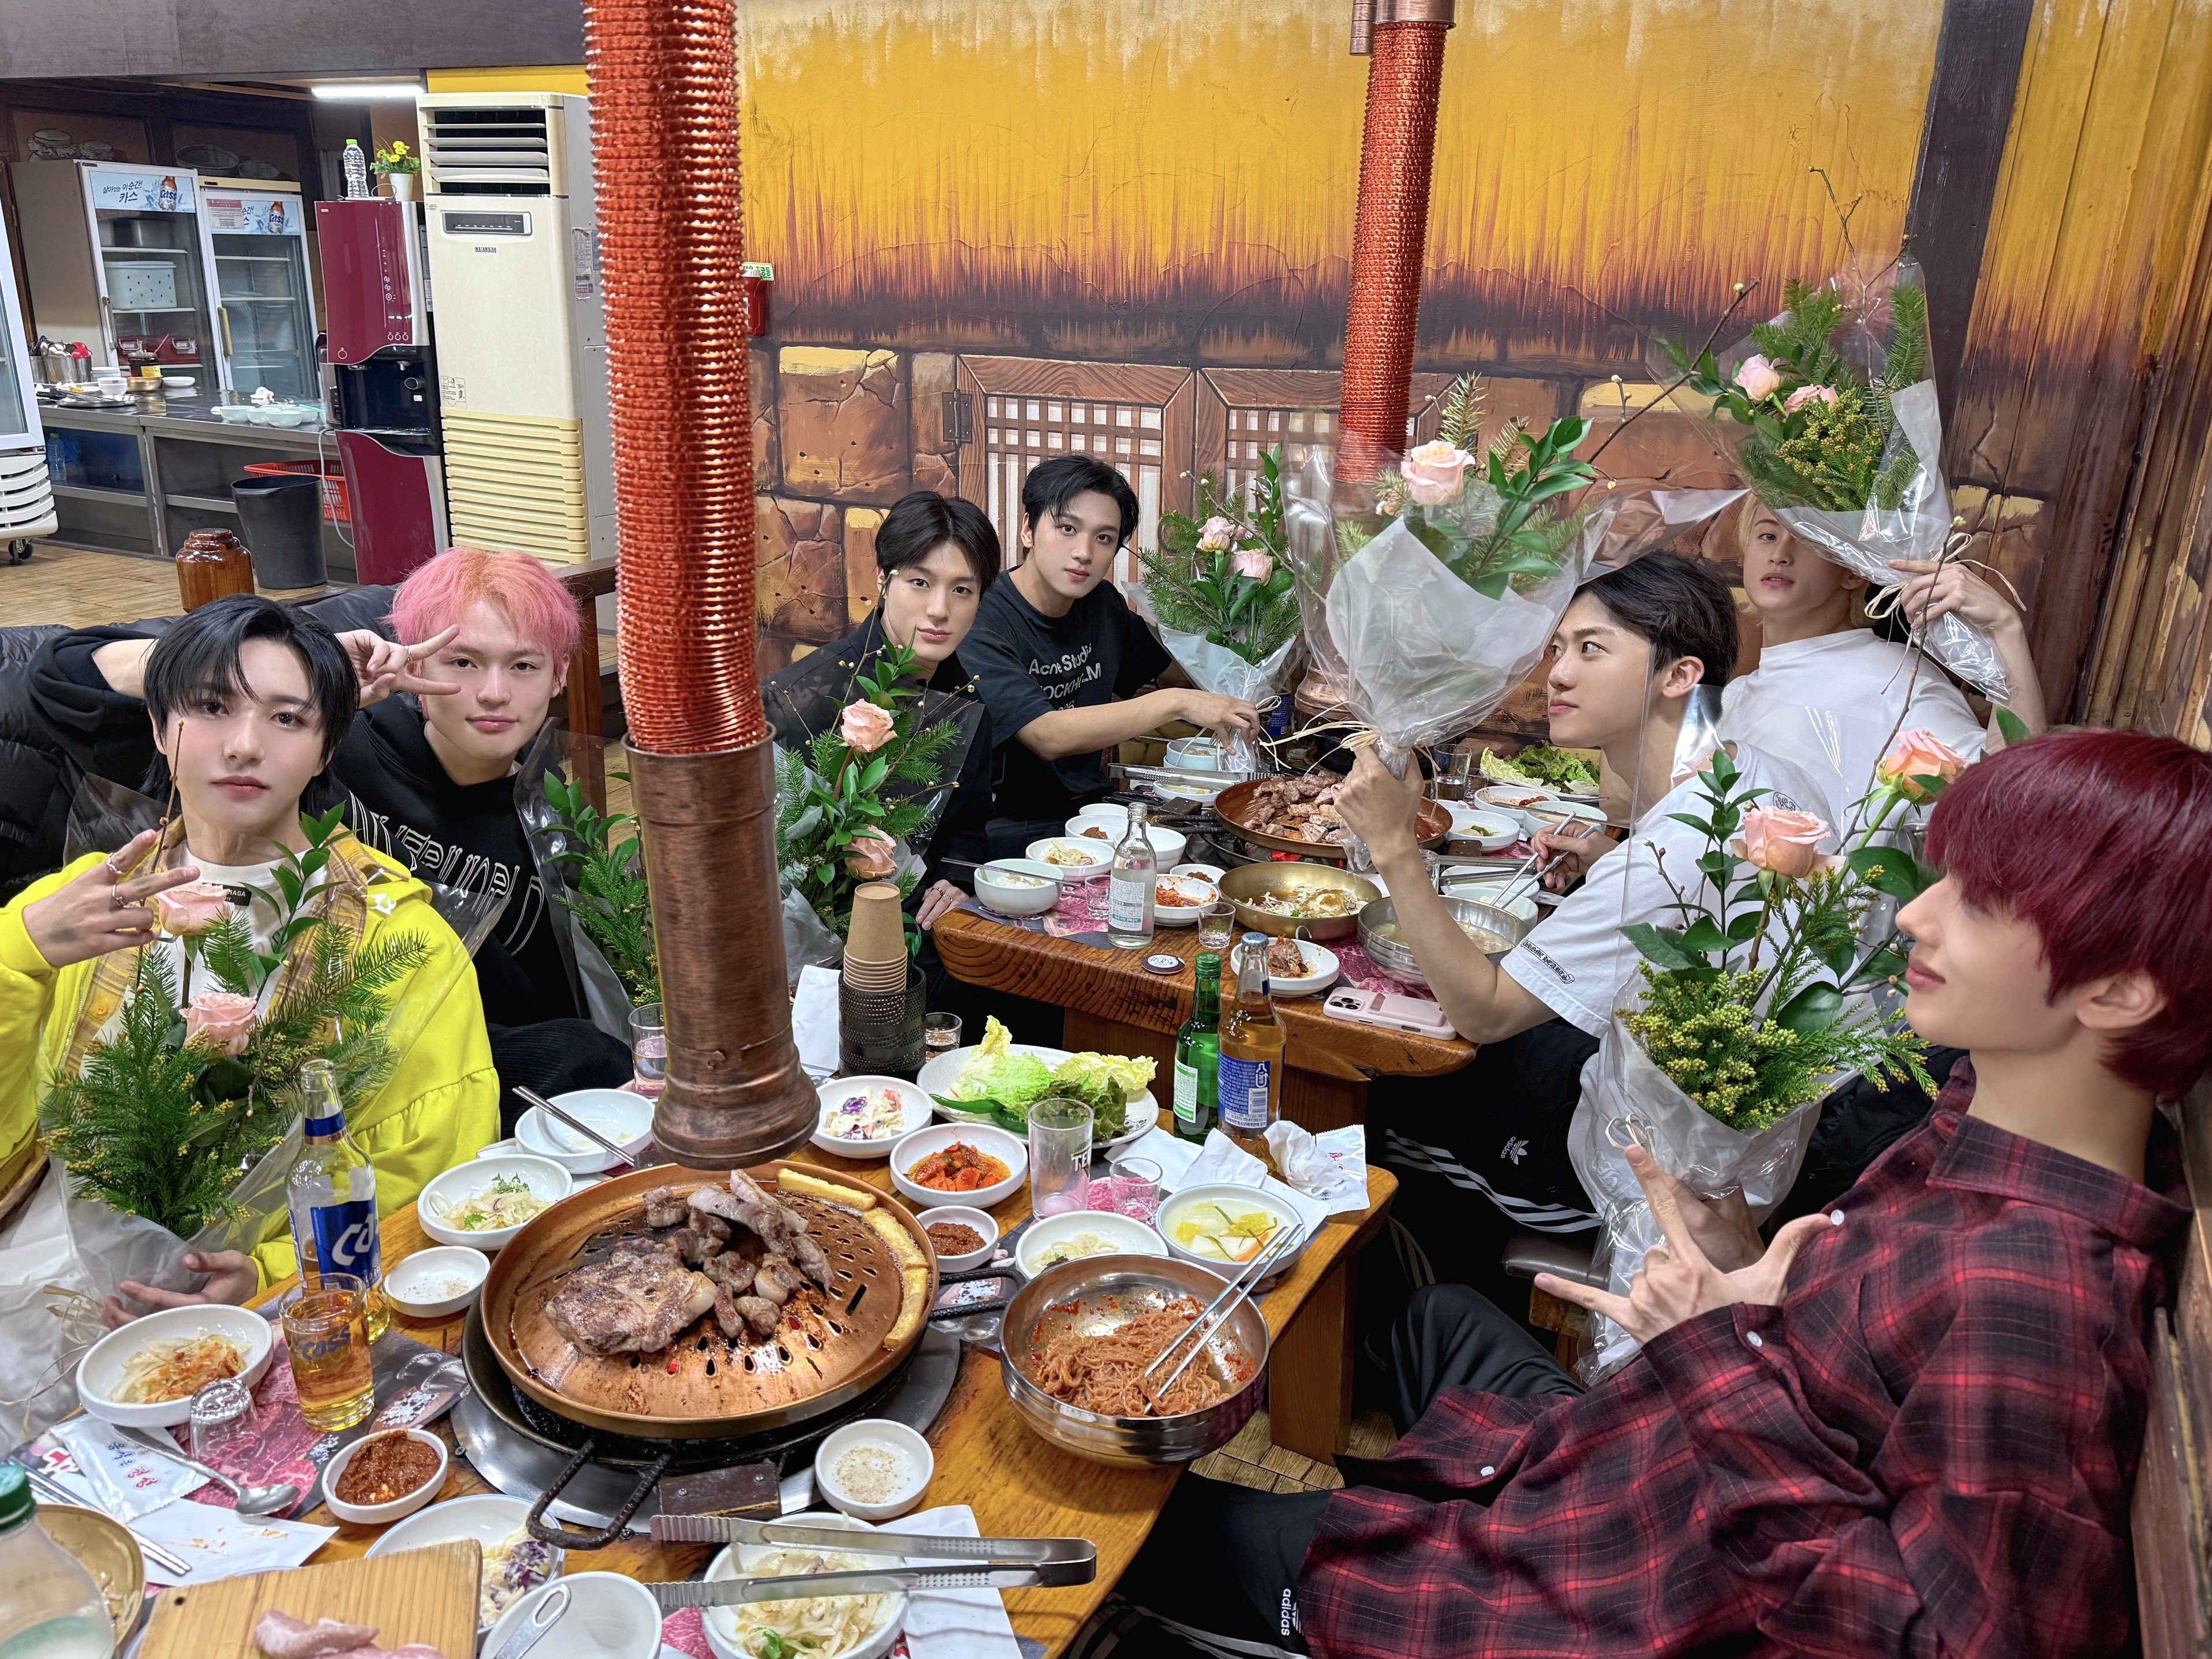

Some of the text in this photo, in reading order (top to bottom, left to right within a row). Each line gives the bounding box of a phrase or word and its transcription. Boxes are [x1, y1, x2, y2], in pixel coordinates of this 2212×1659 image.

[119, 190, 138, 203] 카스
[1029, 642, 1092, 675] Acne Studi
[1501, 1137, 1516, 1159] adidas
[332, 1213, 379, 1266] Ca
[302, 1325, 351, 1361] Cass
[1281, 1589, 1292, 1636] adidas
